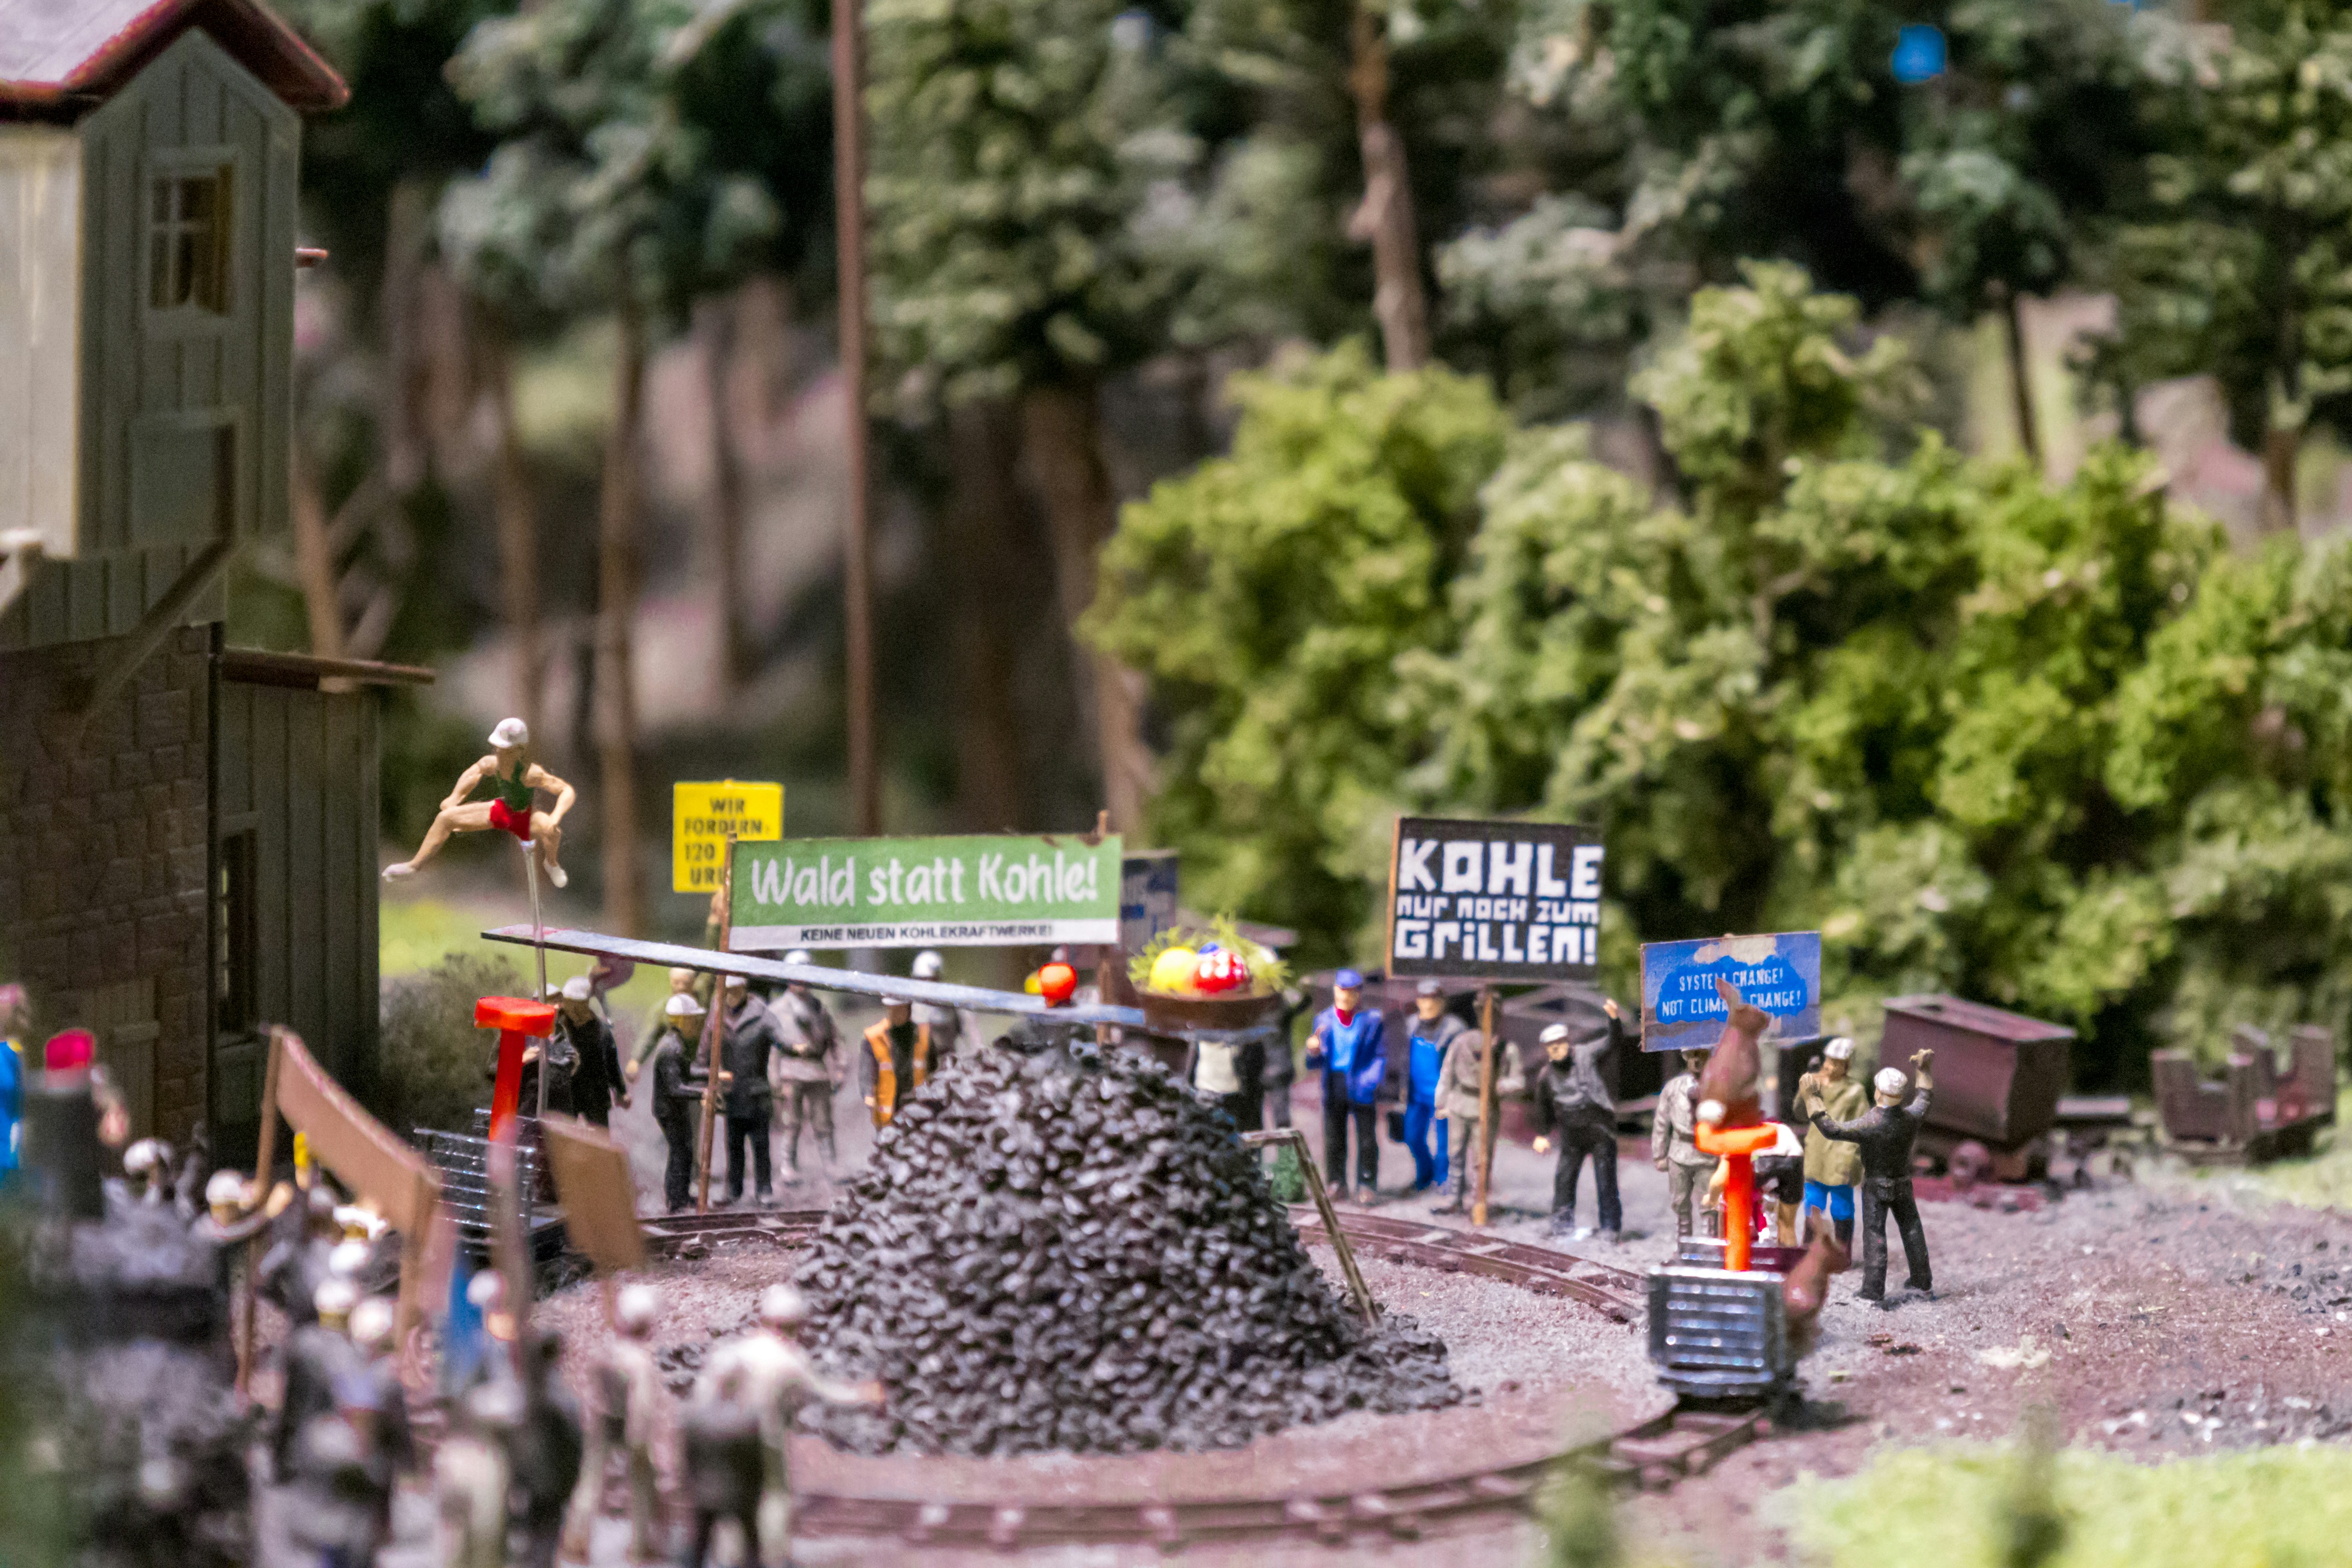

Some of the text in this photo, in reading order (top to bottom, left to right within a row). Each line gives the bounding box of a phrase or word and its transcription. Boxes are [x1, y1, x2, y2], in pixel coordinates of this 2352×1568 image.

[710, 797, 745, 813] WIR
[686, 843, 715, 862] 120
[752, 849, 1098, 907] Wald statt Kohle!
[1399, 838, 1604, 899] KOHLE
[801, 928, 842, 942] KEINE
[847, 927, 895, 940] NEUEN
[1733, 967, 1783, 987] CHANGE!
[1662, 990, 1801, 1016] NOT CLIMA CHANGE!
